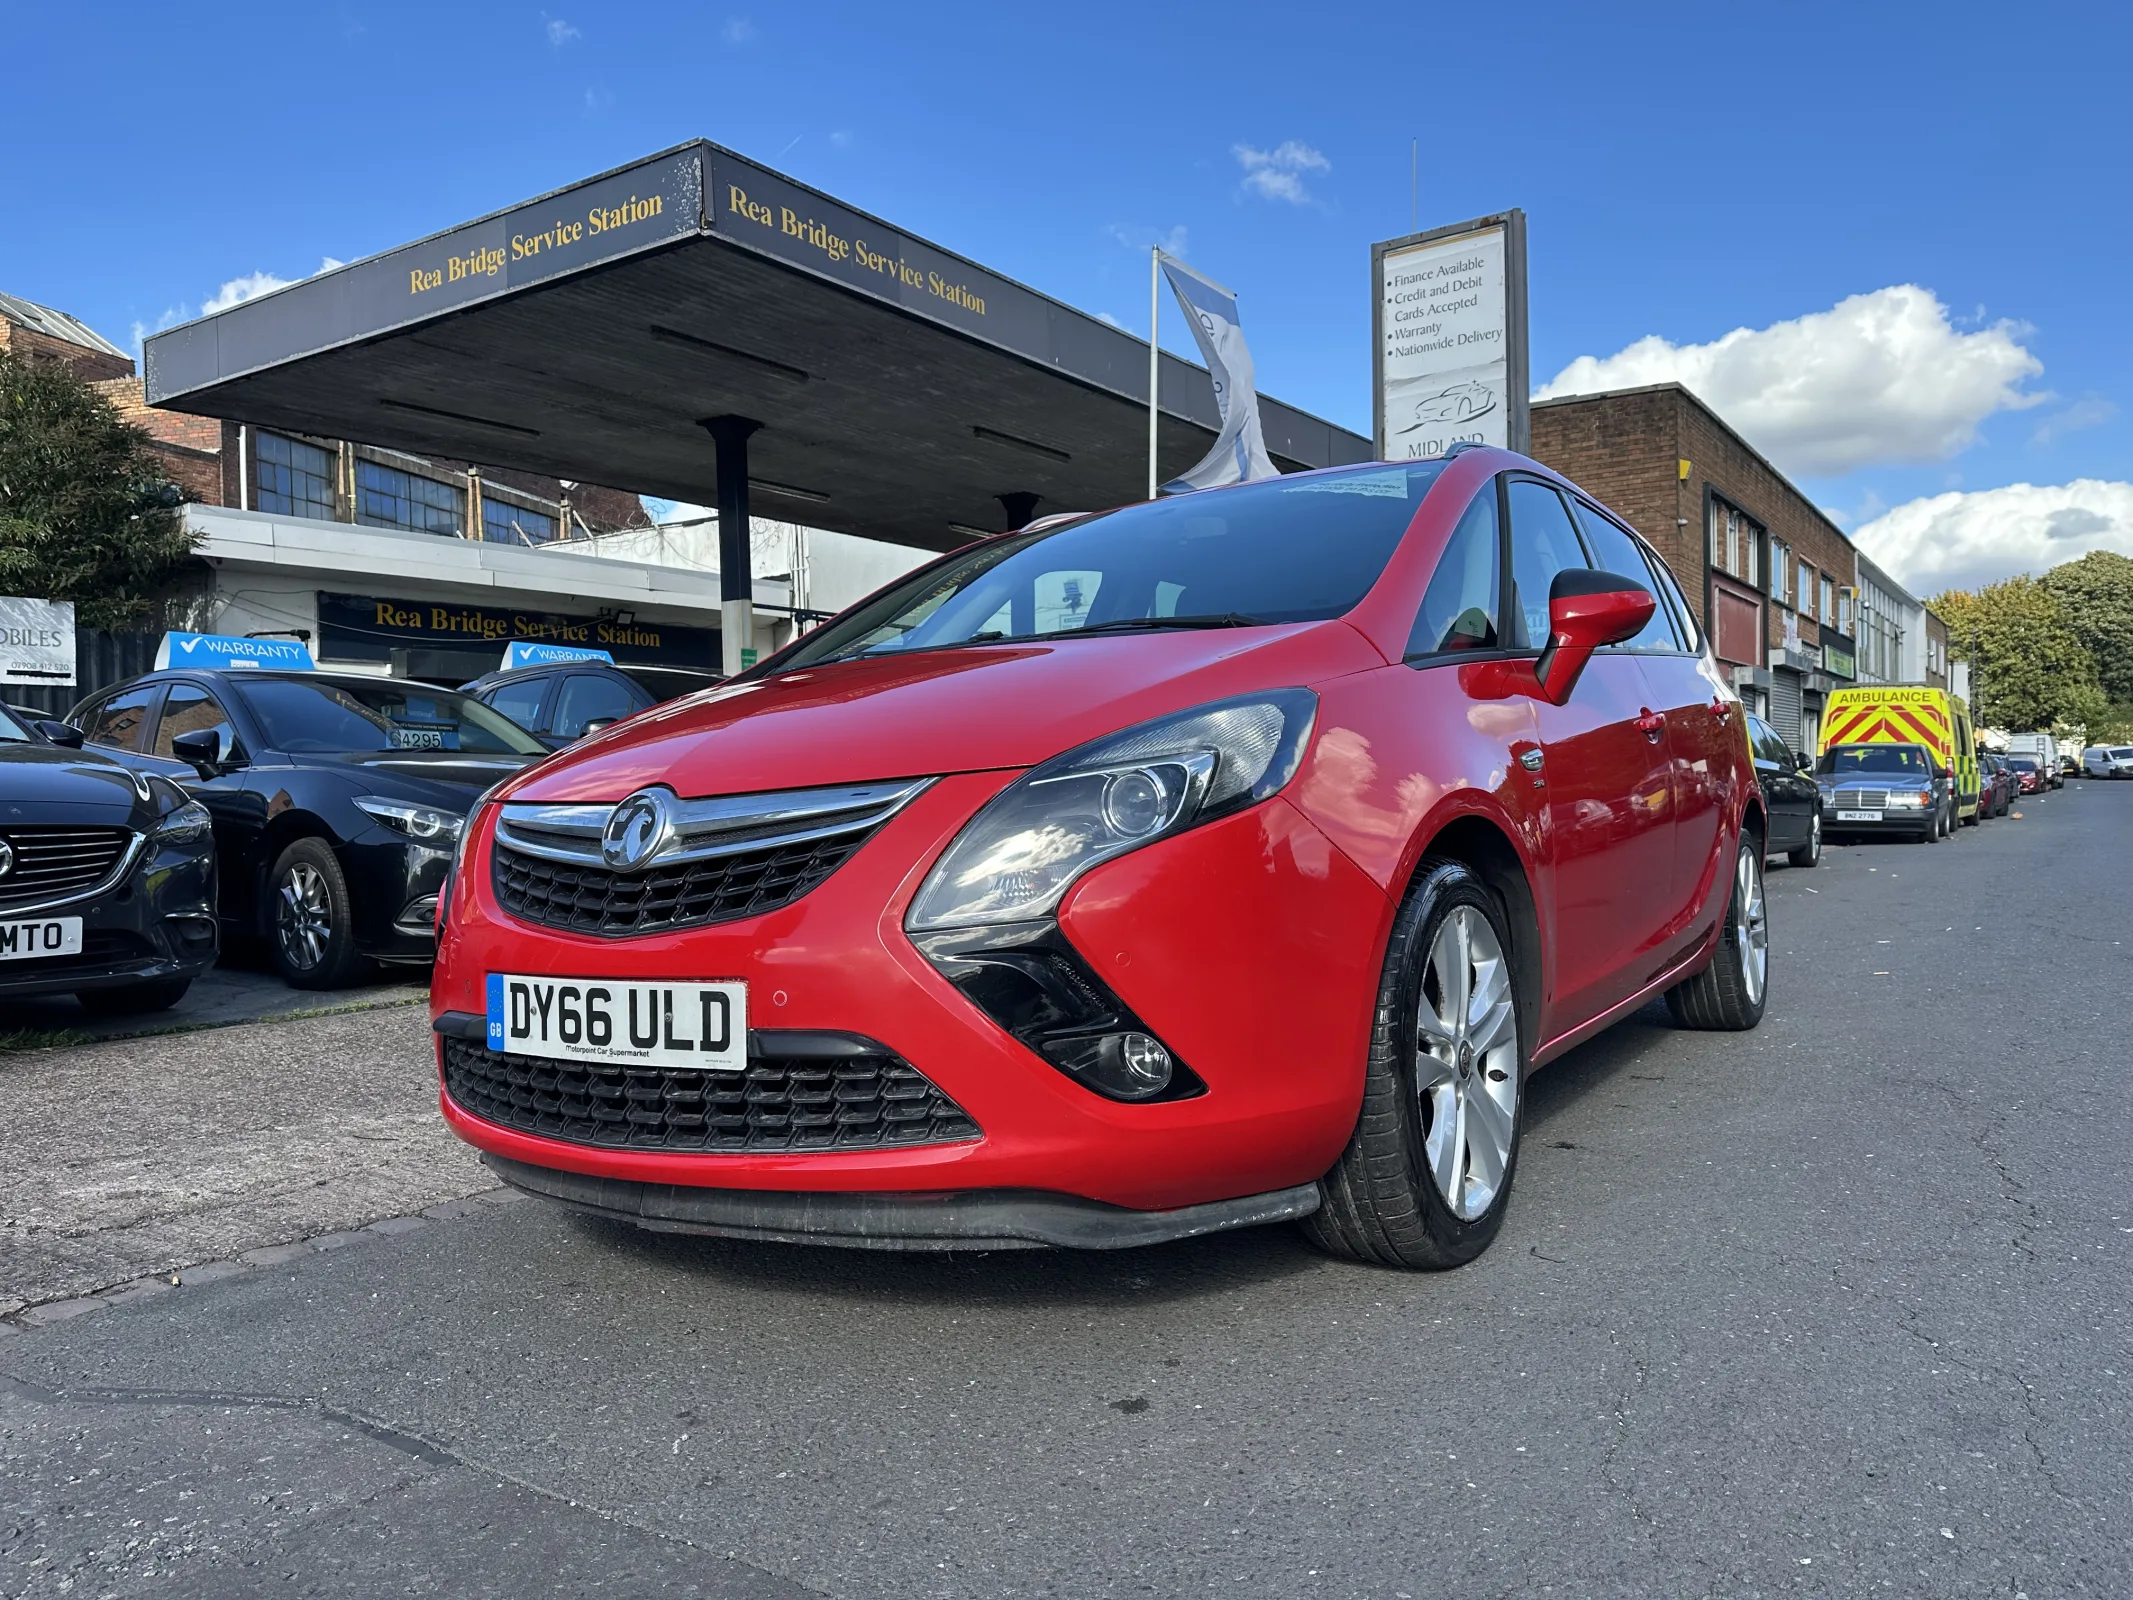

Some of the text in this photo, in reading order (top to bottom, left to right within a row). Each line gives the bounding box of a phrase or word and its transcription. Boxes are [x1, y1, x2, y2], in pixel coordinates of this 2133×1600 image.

[410, 194, 662, 295] Rea Bridge Service Station
[728, 184, 986, 315] Rea Bridge Service Station
[1394, 257, 1485, 287] Finance Available
[1394, 276, 1482, 304] Credit and Debit
[1395, 294, 1477, 322] Cards Accepted
[1395, 323, 1442, 340] Warranty
[1395, 329, 1502, 358] Nationwide Delivery
[375, 603, 660, 647] Rea Bridge Service Station
[204, 639, 299, 660] WARRANTY
[54, 663, 69, 671] 520
[1840, 692, 1931, 703] AMBULANCE
[0, 923, 62, 953] MTO
[490, 1022, 502, 1038] GB
[510, 982, 731, 1052] DY66 ULD
[566, 1045, 597, 1055] Motorpoint
[609, 1048, 650, 1057] Supermarket
